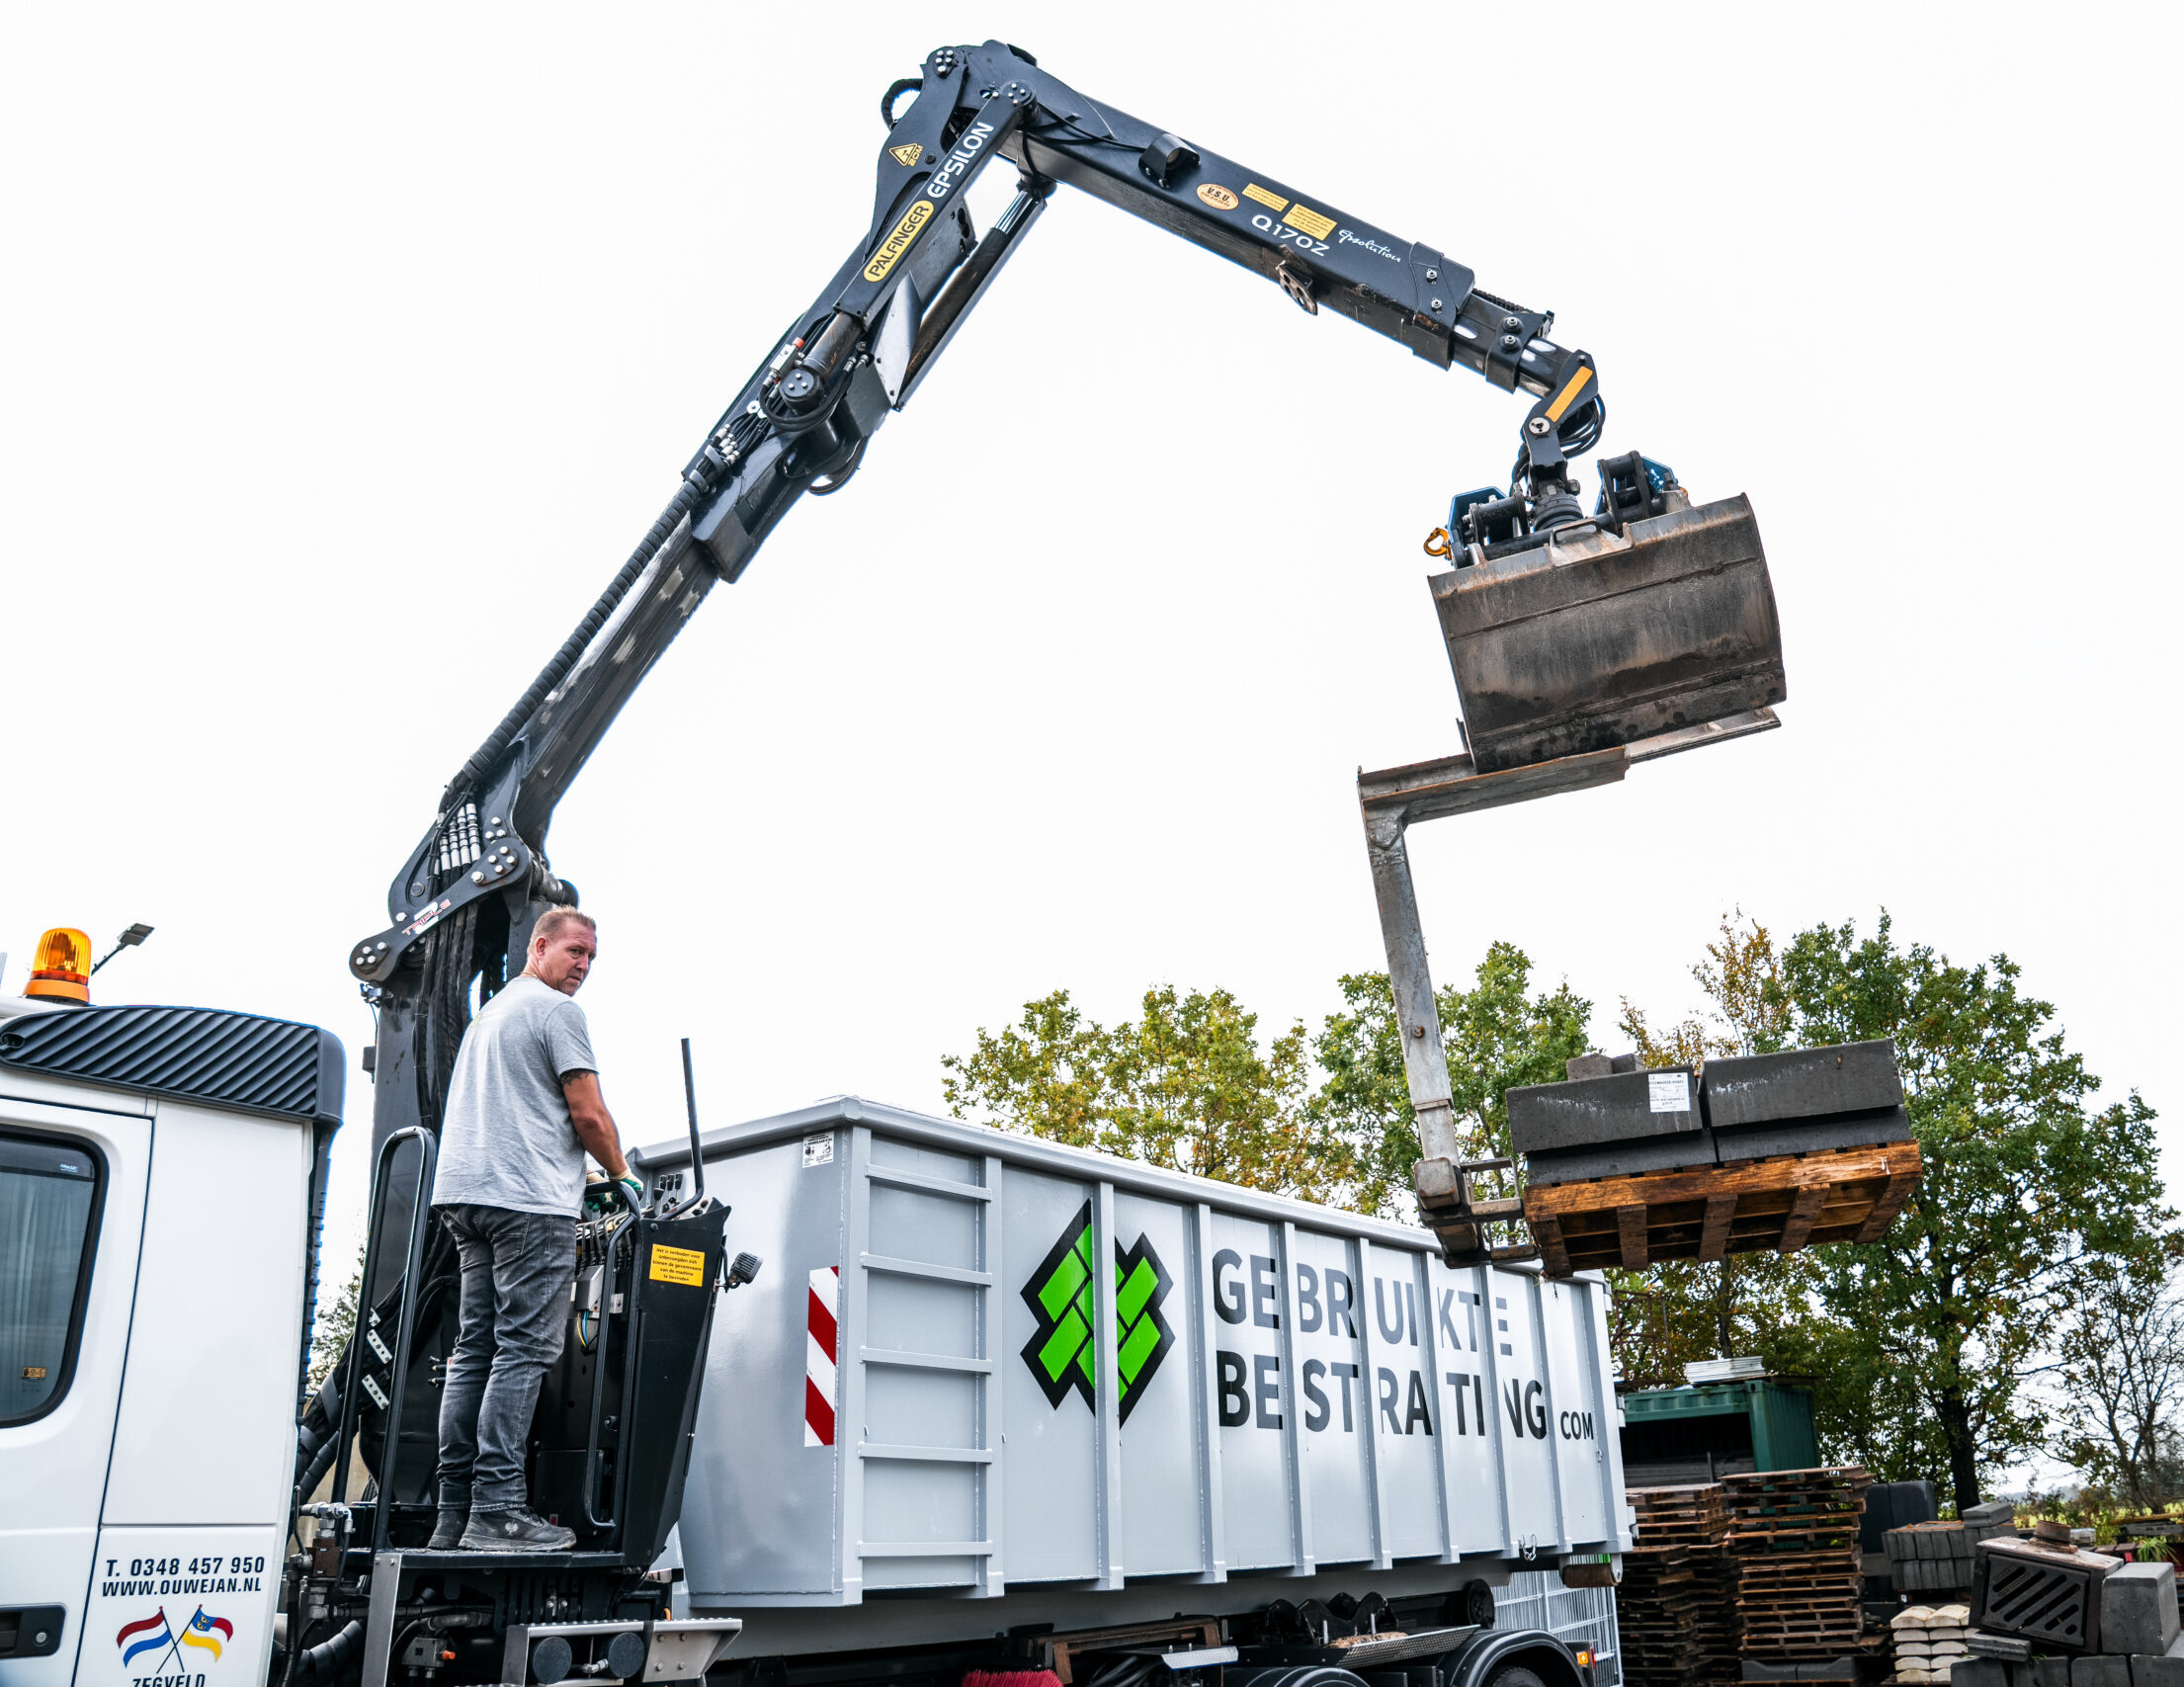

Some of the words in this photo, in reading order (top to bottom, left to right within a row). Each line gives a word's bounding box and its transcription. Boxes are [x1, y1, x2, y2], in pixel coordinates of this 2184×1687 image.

[927, 122, 994, 198] EPSILON
[1208, 188, 1229, 203] V.S.U.
[868, 206, 929, 277] PALFINGER
[1251, 214, 1330, 257] Q170Z
[1338, 229, 1401, 263] Epsolution
[401, 899, 451, 935] TRIPLE
[1216, 1350, 1548, 1440] BESTRATING
[1560, 1410, 1594, 1440] COM
[106, 1560, 121, 1577] T.
[130, 1559, 180, 1576] 0348
[188, 1558, 223, 1575] 457
[230, 1557, 265, 1573] 950
[103, 1577, 261, 1597] WWW.OUWEJAN.NL
